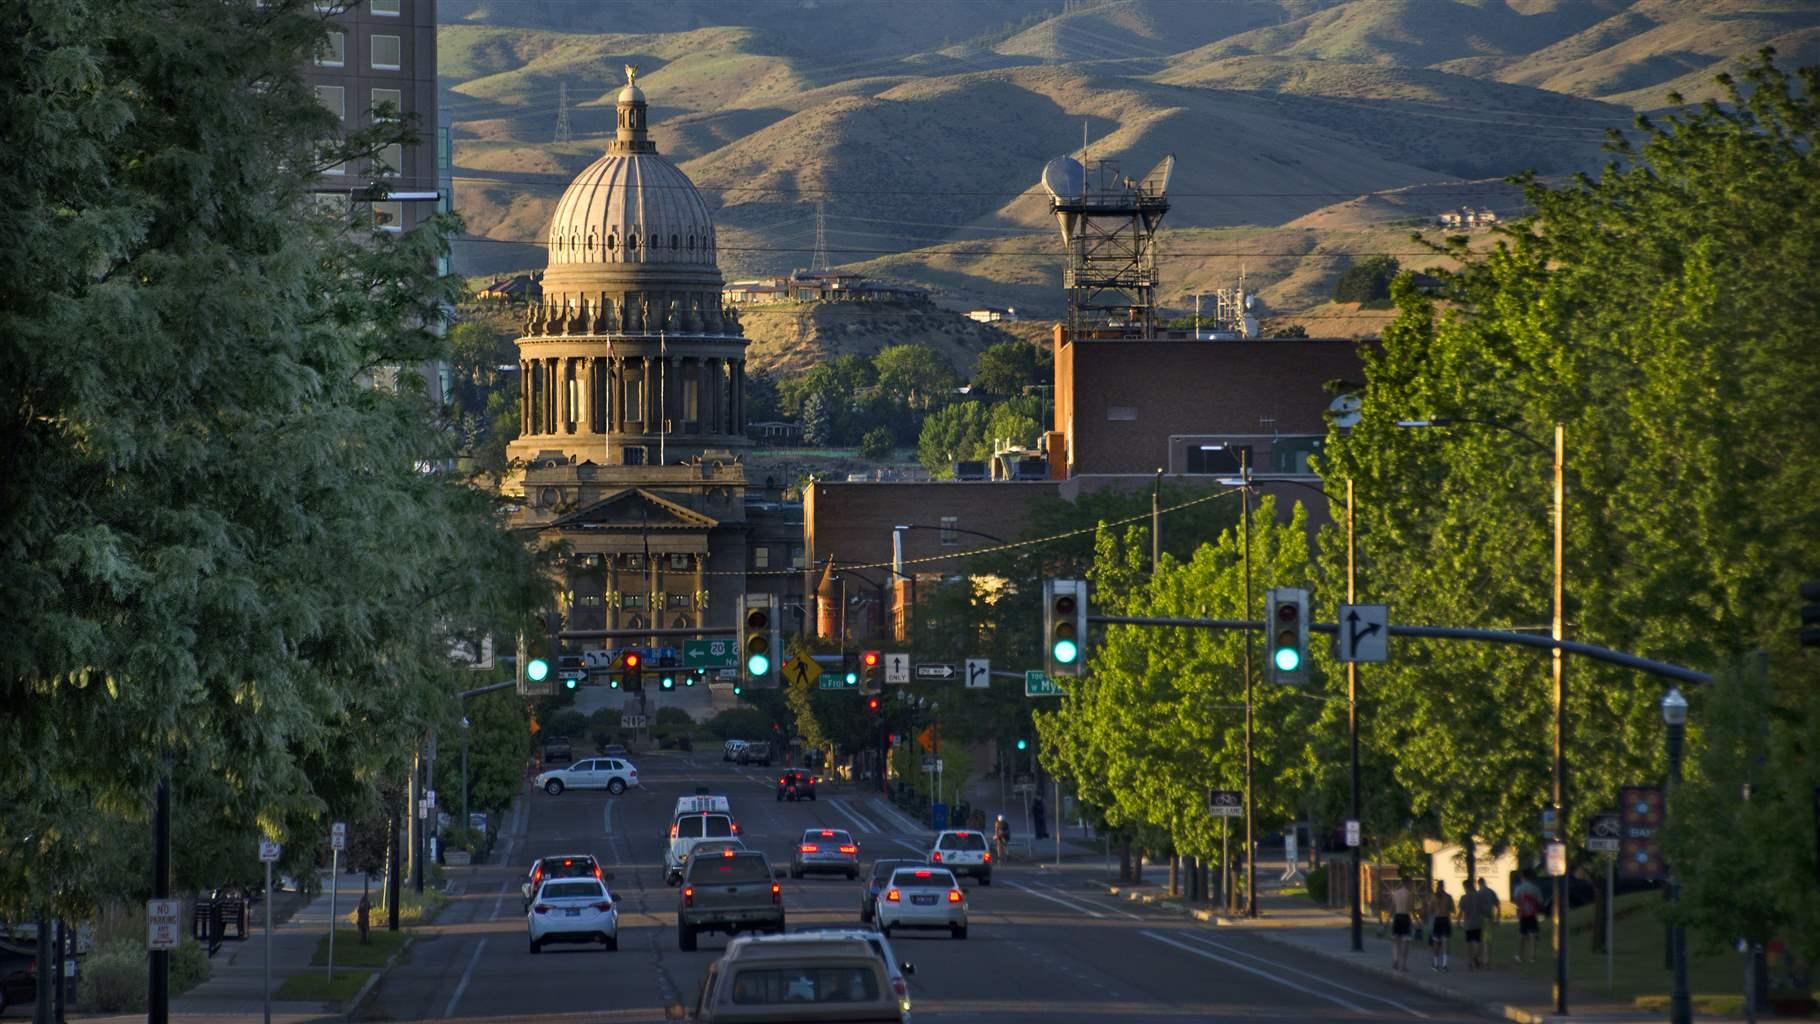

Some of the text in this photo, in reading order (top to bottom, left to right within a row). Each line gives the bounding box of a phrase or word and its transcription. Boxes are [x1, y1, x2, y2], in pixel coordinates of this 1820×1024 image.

[712, 643, 723, 653] 20
[888, 673, 906, 681] ONLY
[1211, 807, 1240, 815] BIKE LANE
[157, 904, 169, 914] NO
[150, 916, 176, 925] PARKING
